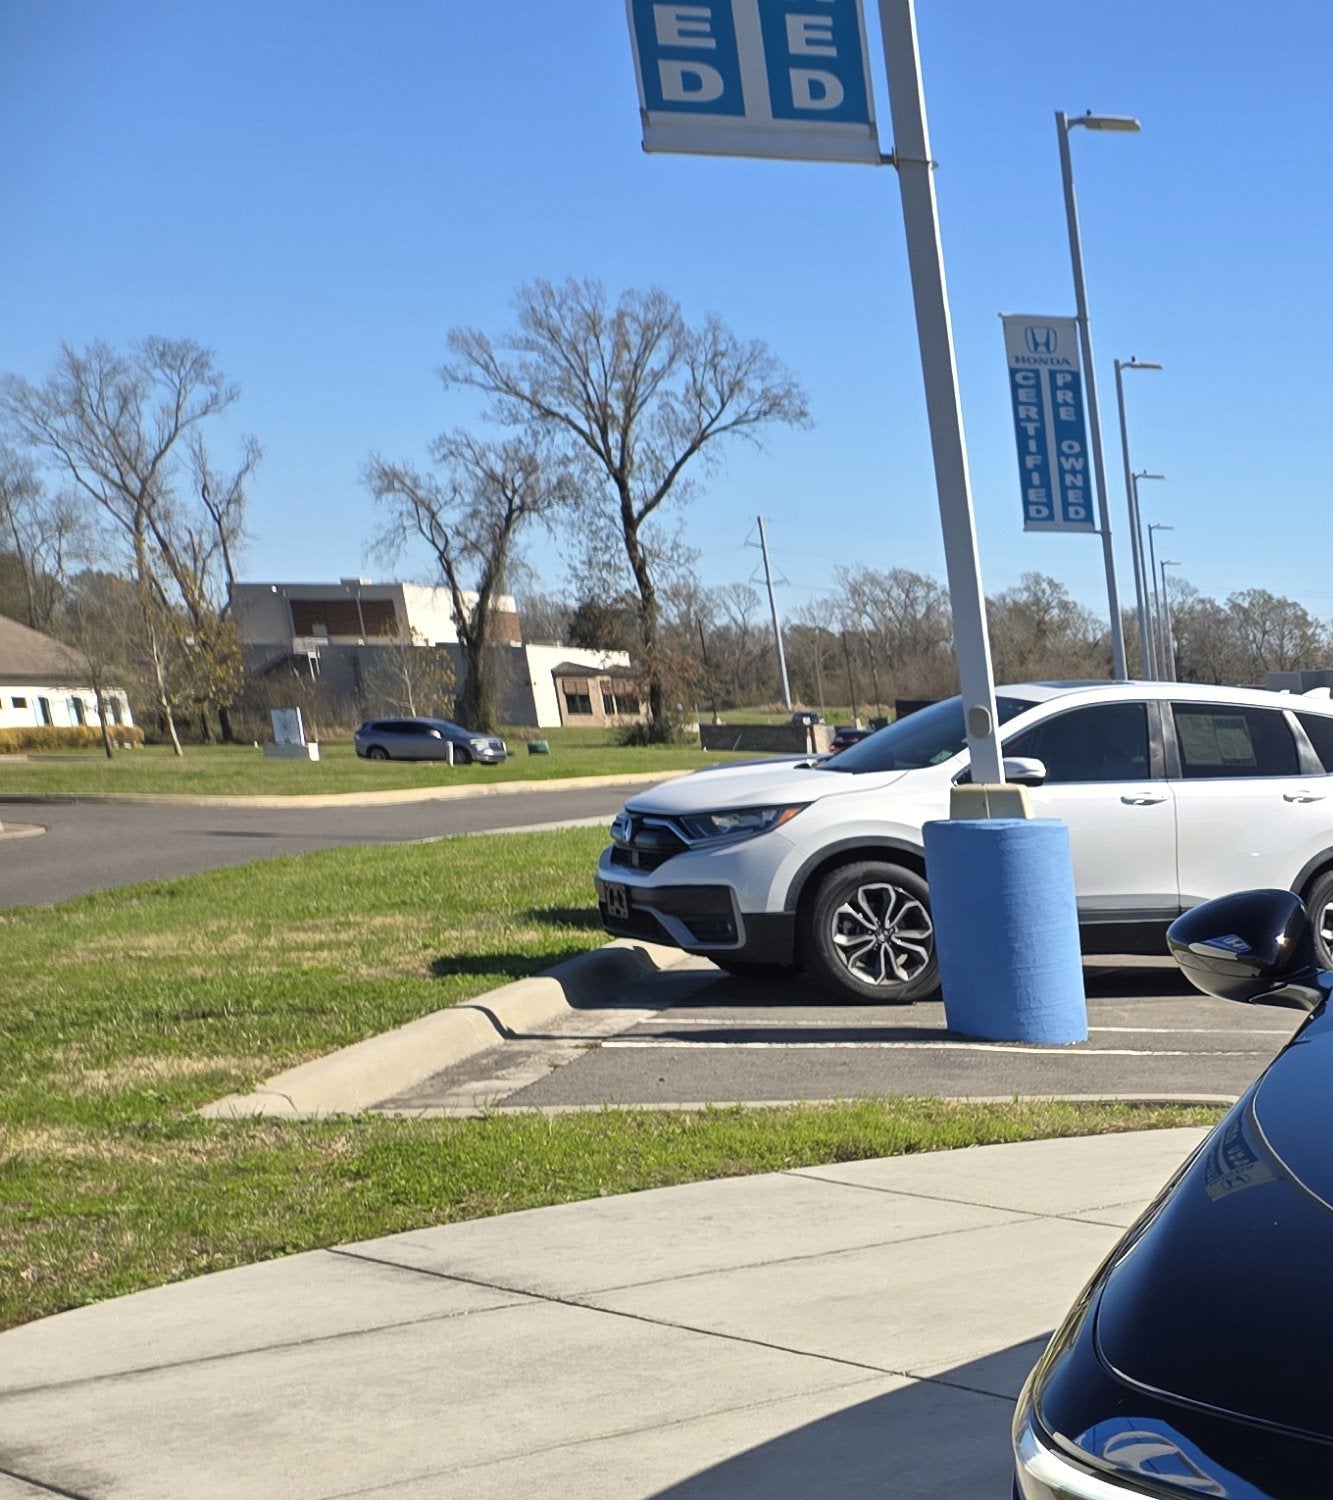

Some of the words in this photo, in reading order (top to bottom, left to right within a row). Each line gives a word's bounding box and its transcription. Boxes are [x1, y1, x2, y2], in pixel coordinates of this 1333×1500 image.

[1014, 355, 1072, 367] HONDA
[1055, 372, 1077, 421] PRE
[1014, 371, 1050, 519] CERTIFIED
[1060, 440, 1087, 520] OWNED
